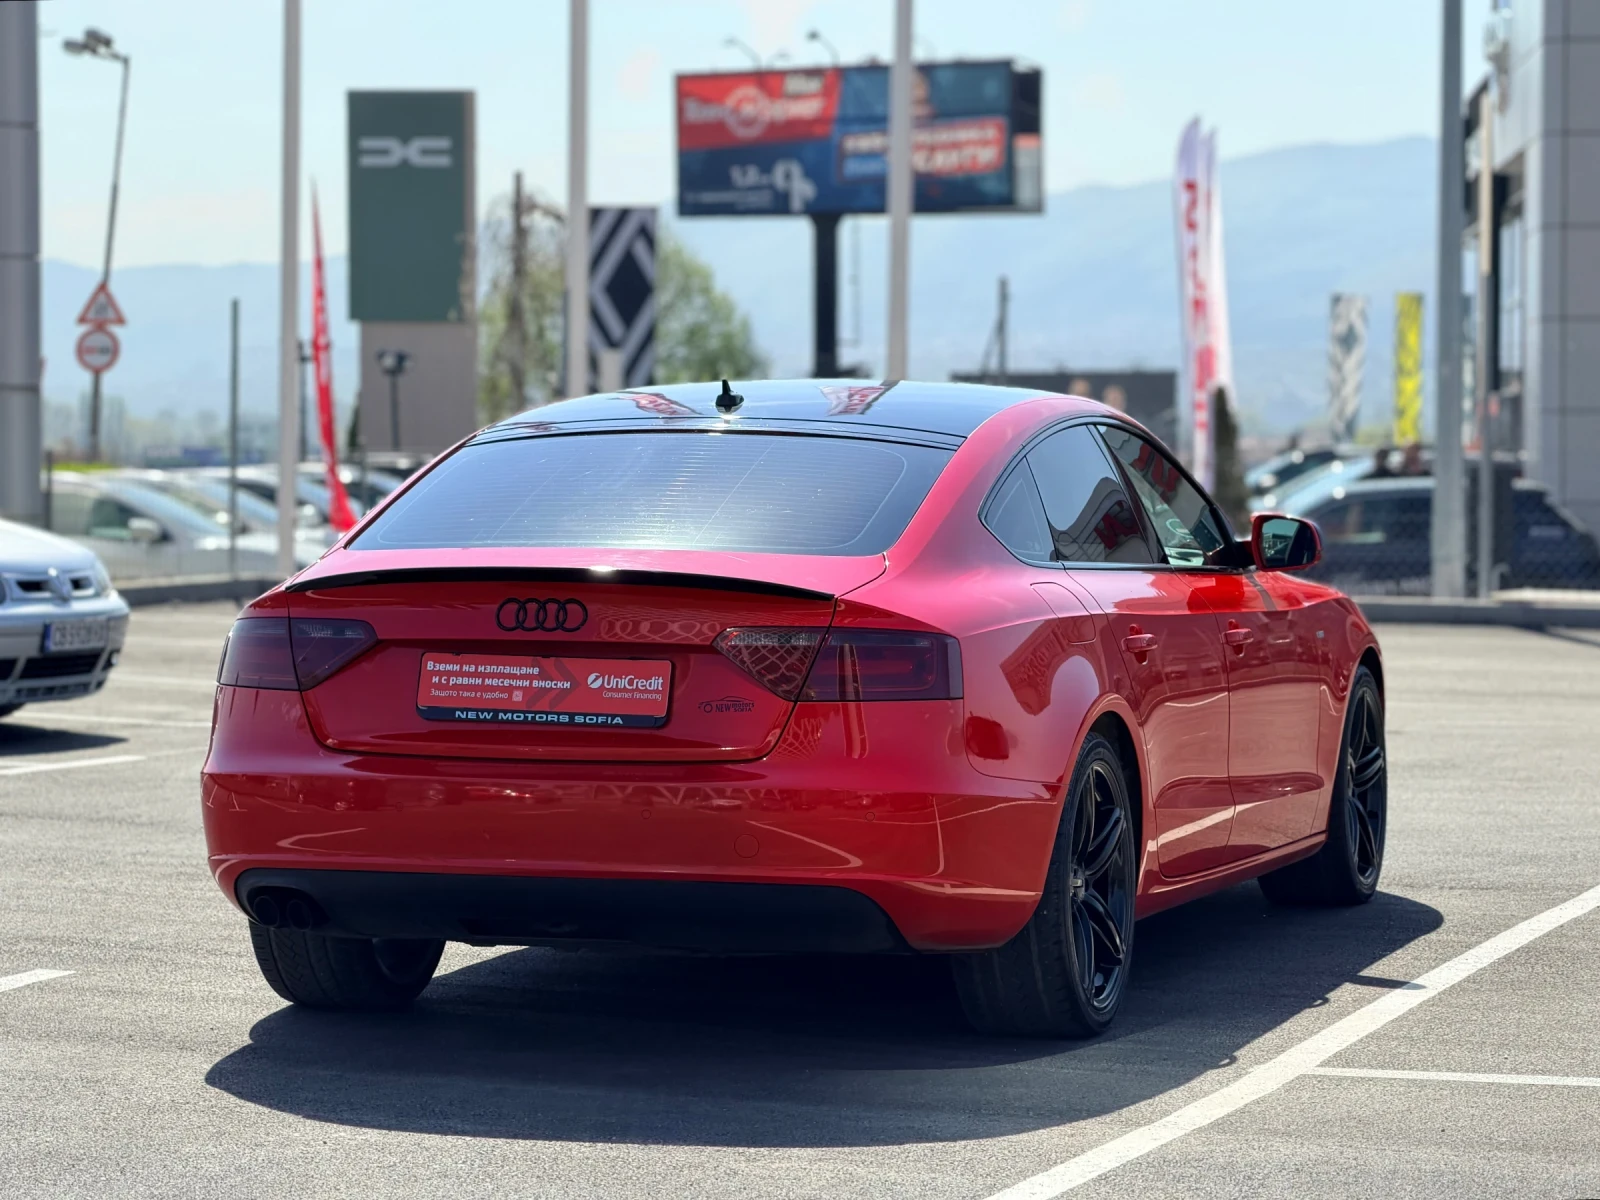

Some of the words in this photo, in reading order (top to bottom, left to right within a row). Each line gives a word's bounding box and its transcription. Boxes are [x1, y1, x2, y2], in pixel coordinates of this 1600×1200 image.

[427, 661, 460, 671] Вземи
[462, 664, 475, 672] на
[478, 664, 539, 675] изплащане
[449, 676, 482, 686] равни
[484, 678, 530, 687] месечни
[532, 680, 571, 689] вноски
[604, 674, 664, 690] UniCredit
[430, 688, 457, 697] Защото
[459, 690, 475, 698] така
[482, 690, 508, 700] удобно
[603, 690, 632, 699] Consumer
[634, 691, 661, 701] Financing
[715, 703, 731, 713] NEW
[455, 710, 493, 720] NEW
[498, 712, 569, 723] MOTORS
[574, 715, 623, 725] SOFIA
